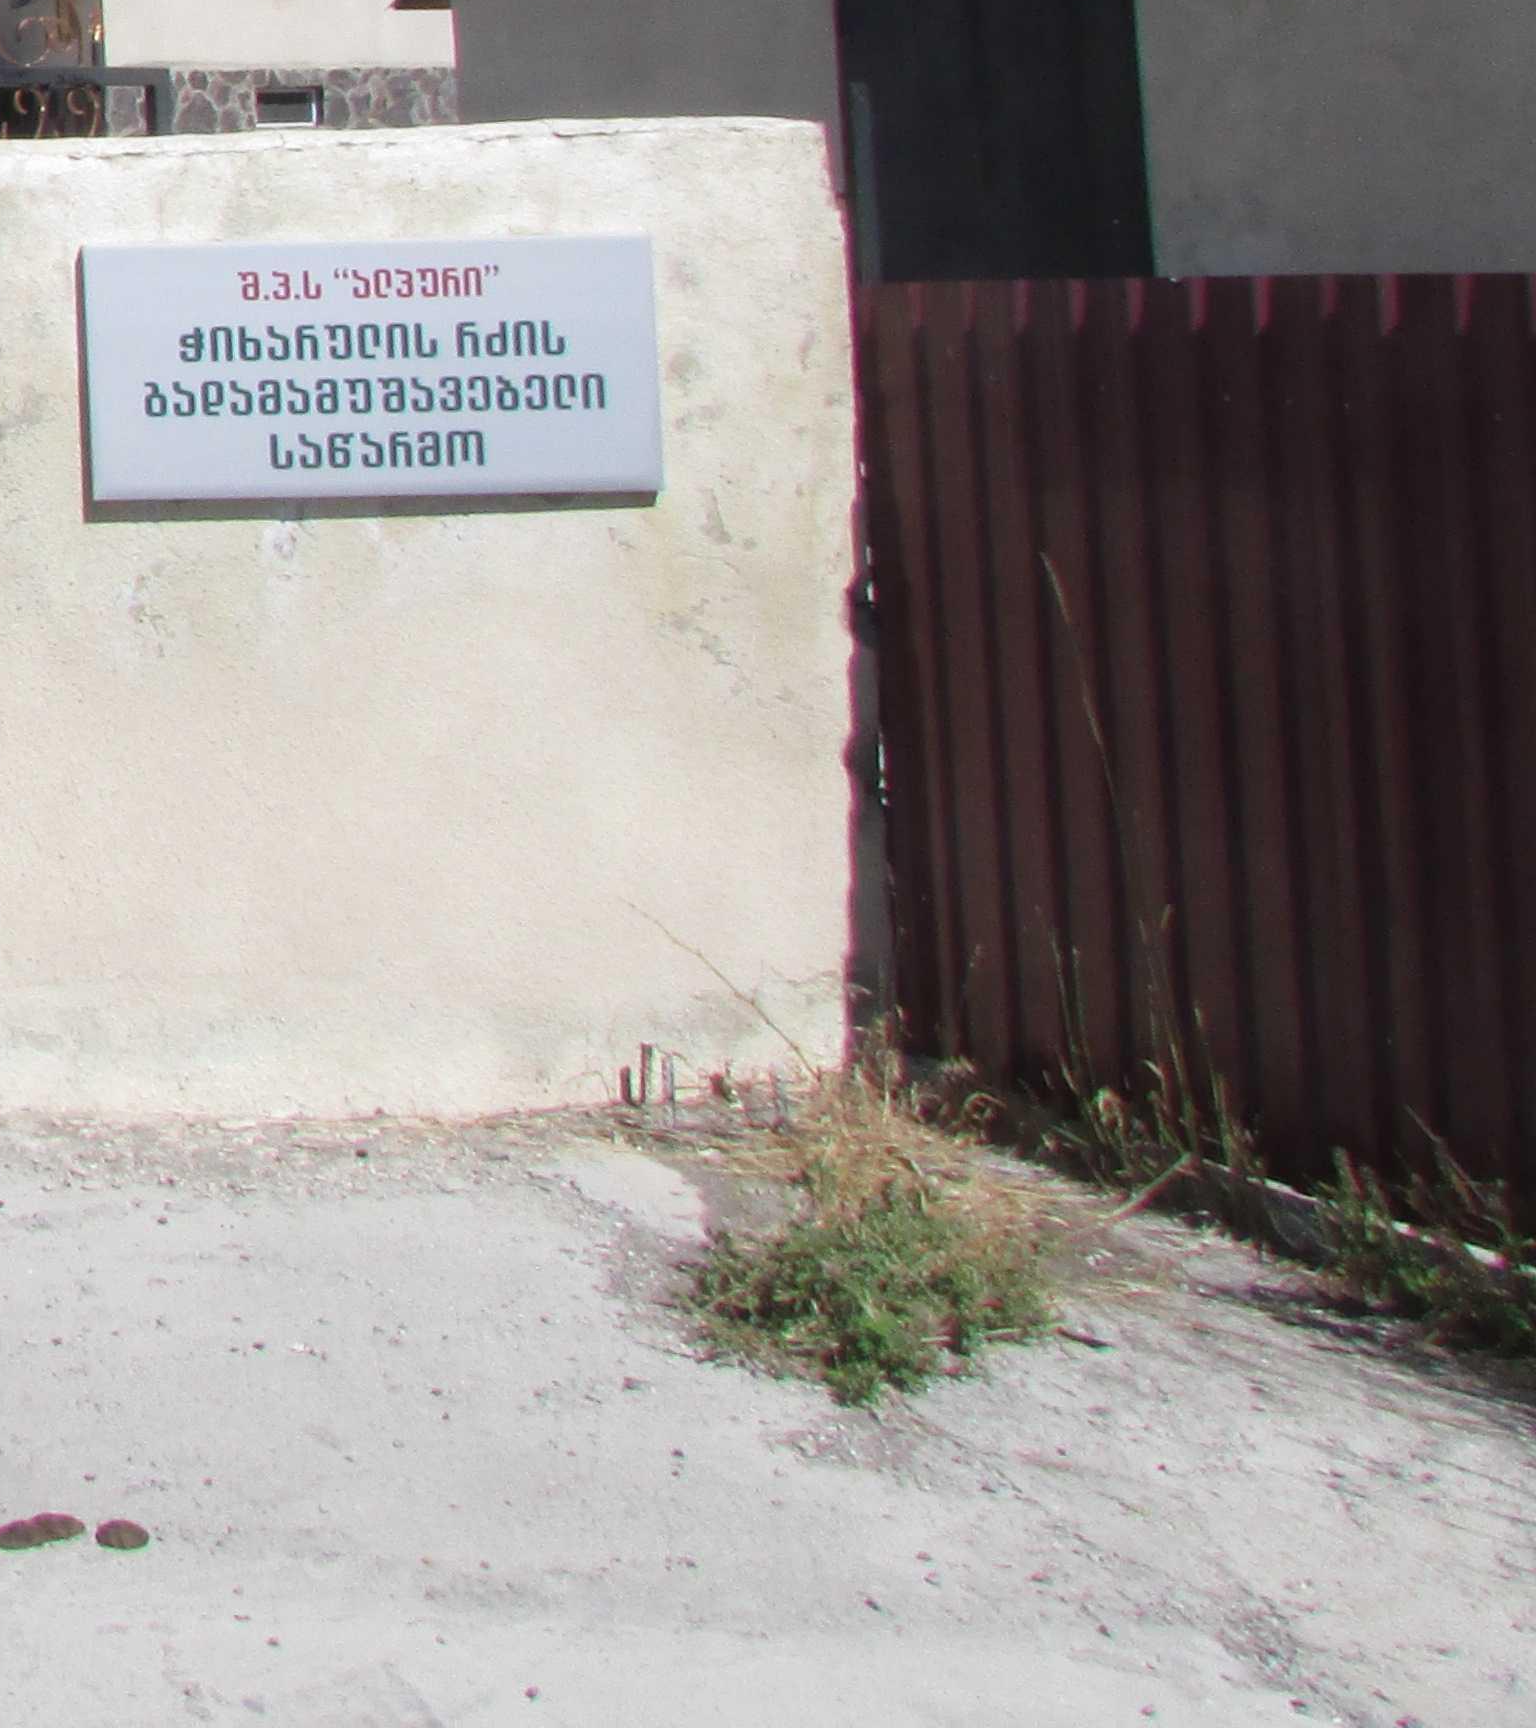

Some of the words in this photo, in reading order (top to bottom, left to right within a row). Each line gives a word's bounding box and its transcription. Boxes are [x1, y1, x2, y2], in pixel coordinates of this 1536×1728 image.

[238, 270, 322, 301] შ.პ.ს
[455, 319, 567, 357] რძის
[144, 373, 606, 417] გადამამუშავებელი
[269, 430, 487, 470] საწარმო
